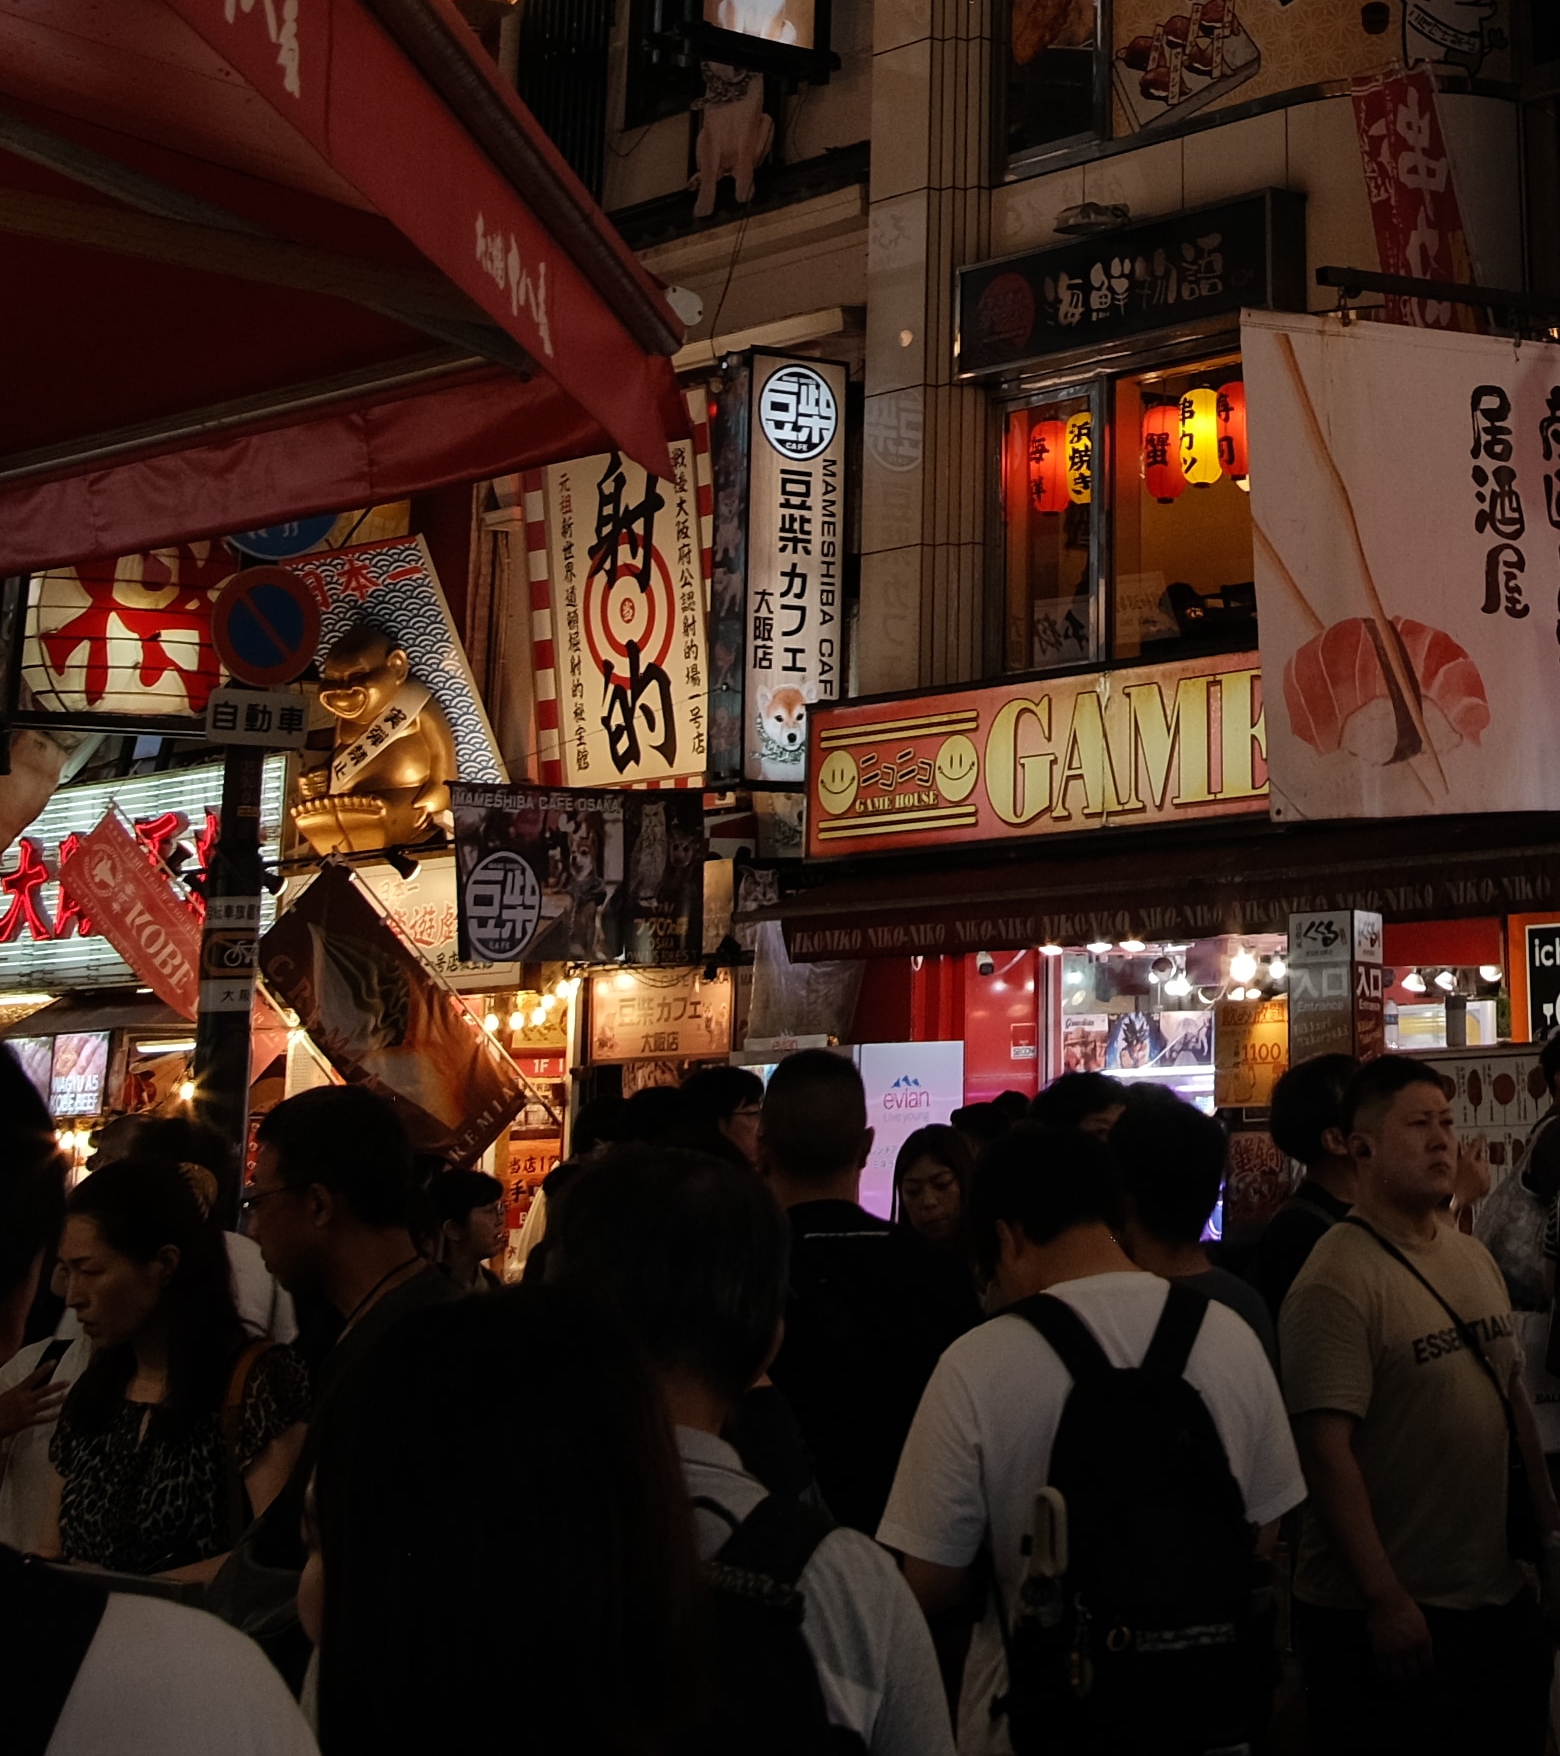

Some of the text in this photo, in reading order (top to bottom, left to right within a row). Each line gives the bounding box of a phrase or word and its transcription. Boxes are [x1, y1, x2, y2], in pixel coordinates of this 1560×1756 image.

[1044, 231, 1225, 328] 海鮮物語
[761, 368, 835, 442] 豆柴
[784, 440, 809, 451] CAFE
[1068, 421, 1093, 496] 浜焼き
[1469, 384, 1531, 620] 居酒屋
[778, 467, 814, 674] 豆柴カフェ
[818, 458, 839, 697] MAMESHIBA CAF
[587, 450, 678, 776] 射的
[752, 589, 775, 672] 大阪店
[212, 701, 305, 733] 自動車
[985, 664, 1271, 828] GAME
[453, 789, 622, 814] MAMESHIBA CAFE OSAKA
[855, 789, 938, 813] GAME HOUSE
[858, 746, 936, 792] ニコニコ
[467, 862, 539, 942] 豆柴
[123, 903, 197, 996] KOBE
[1293, 966, 1351, 997] 入口
[1356, 966, 1383, 997] 入口
[618, 995, 703, 1028] 豆柴カフェ
[641, 1031, 680, 1054] 大阪店
[1297, 998, 1346, 1014] Entrance
[447, 1084, 517, 1162] REMIA
[882, 1089, 931, 1111] evian
